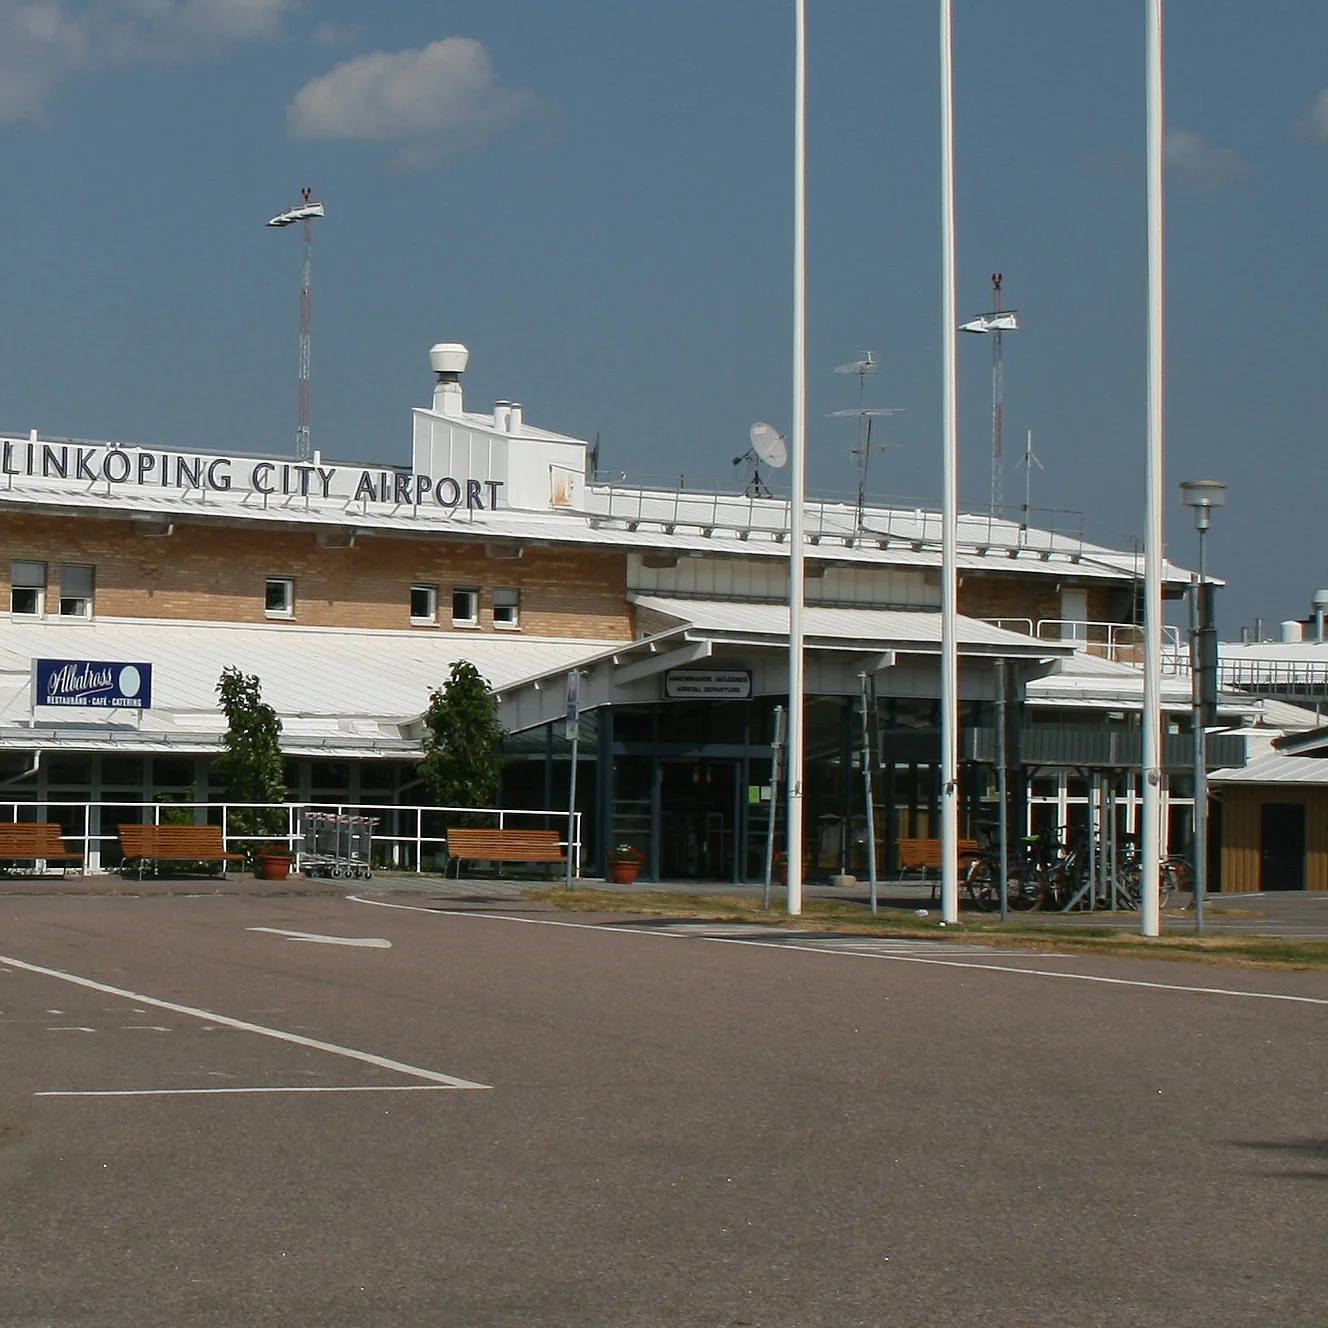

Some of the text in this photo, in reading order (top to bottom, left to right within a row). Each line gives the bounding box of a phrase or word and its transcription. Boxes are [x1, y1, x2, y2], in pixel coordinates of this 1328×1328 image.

[2, 441, 504, 510] LINKÖPING CITY AIRPORT
[48, 662, 113, 696] Albatross
